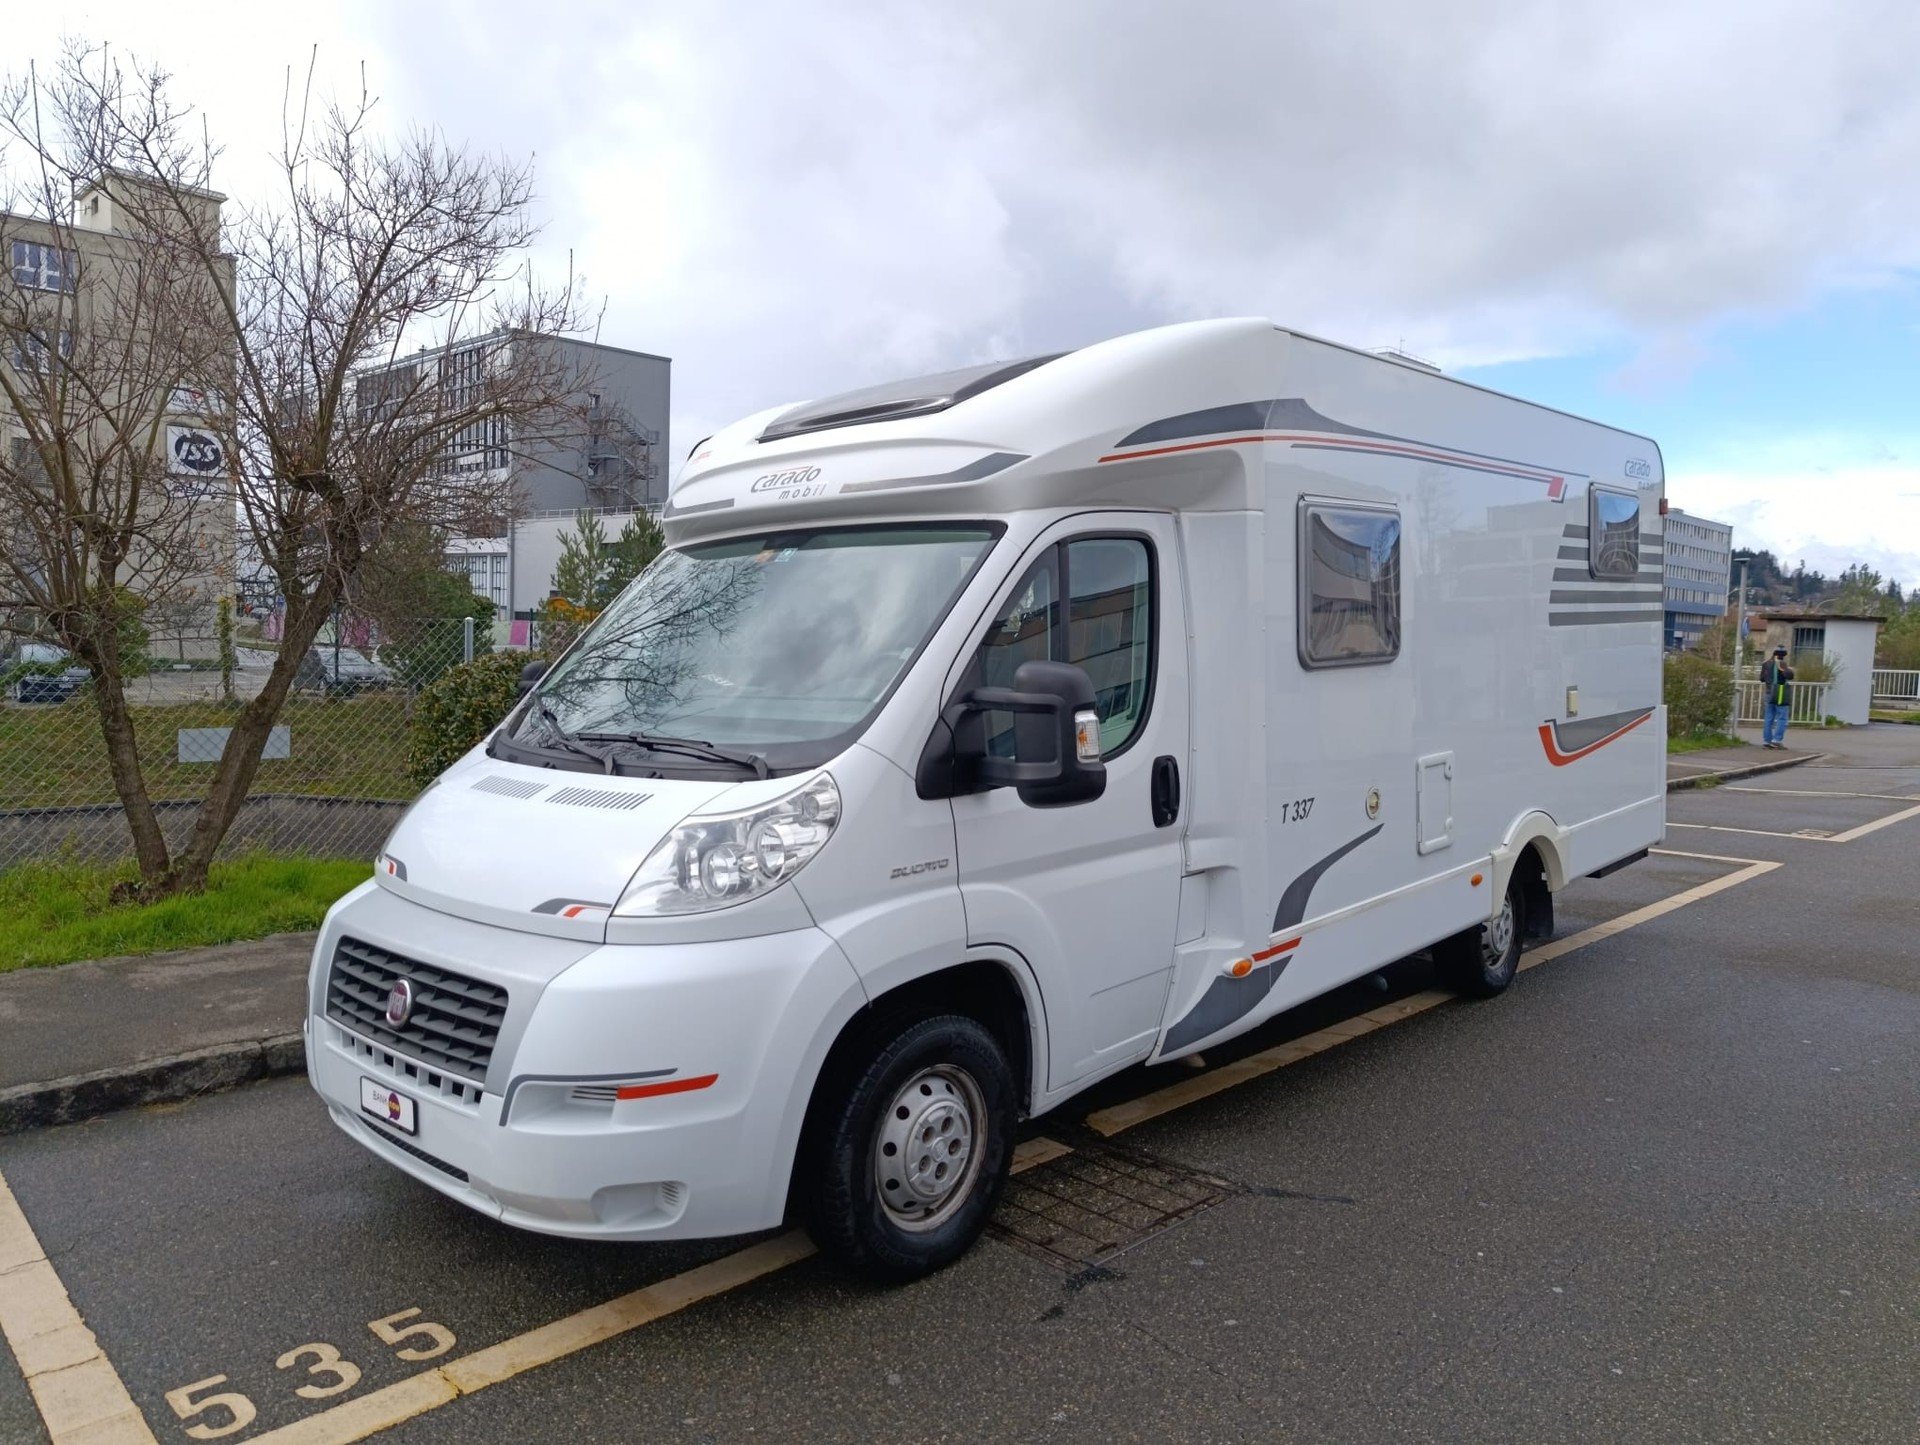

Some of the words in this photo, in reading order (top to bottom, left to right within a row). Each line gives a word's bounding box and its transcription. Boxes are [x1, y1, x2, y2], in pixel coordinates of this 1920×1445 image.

[179, 441, 216, 462] ISS
[778, 484, 827, 500] mobil
[1282, 803, 1289, 824] T
[1292, 797, 1315, 822] 337
[890, 858, 949, 879] DUCATO
